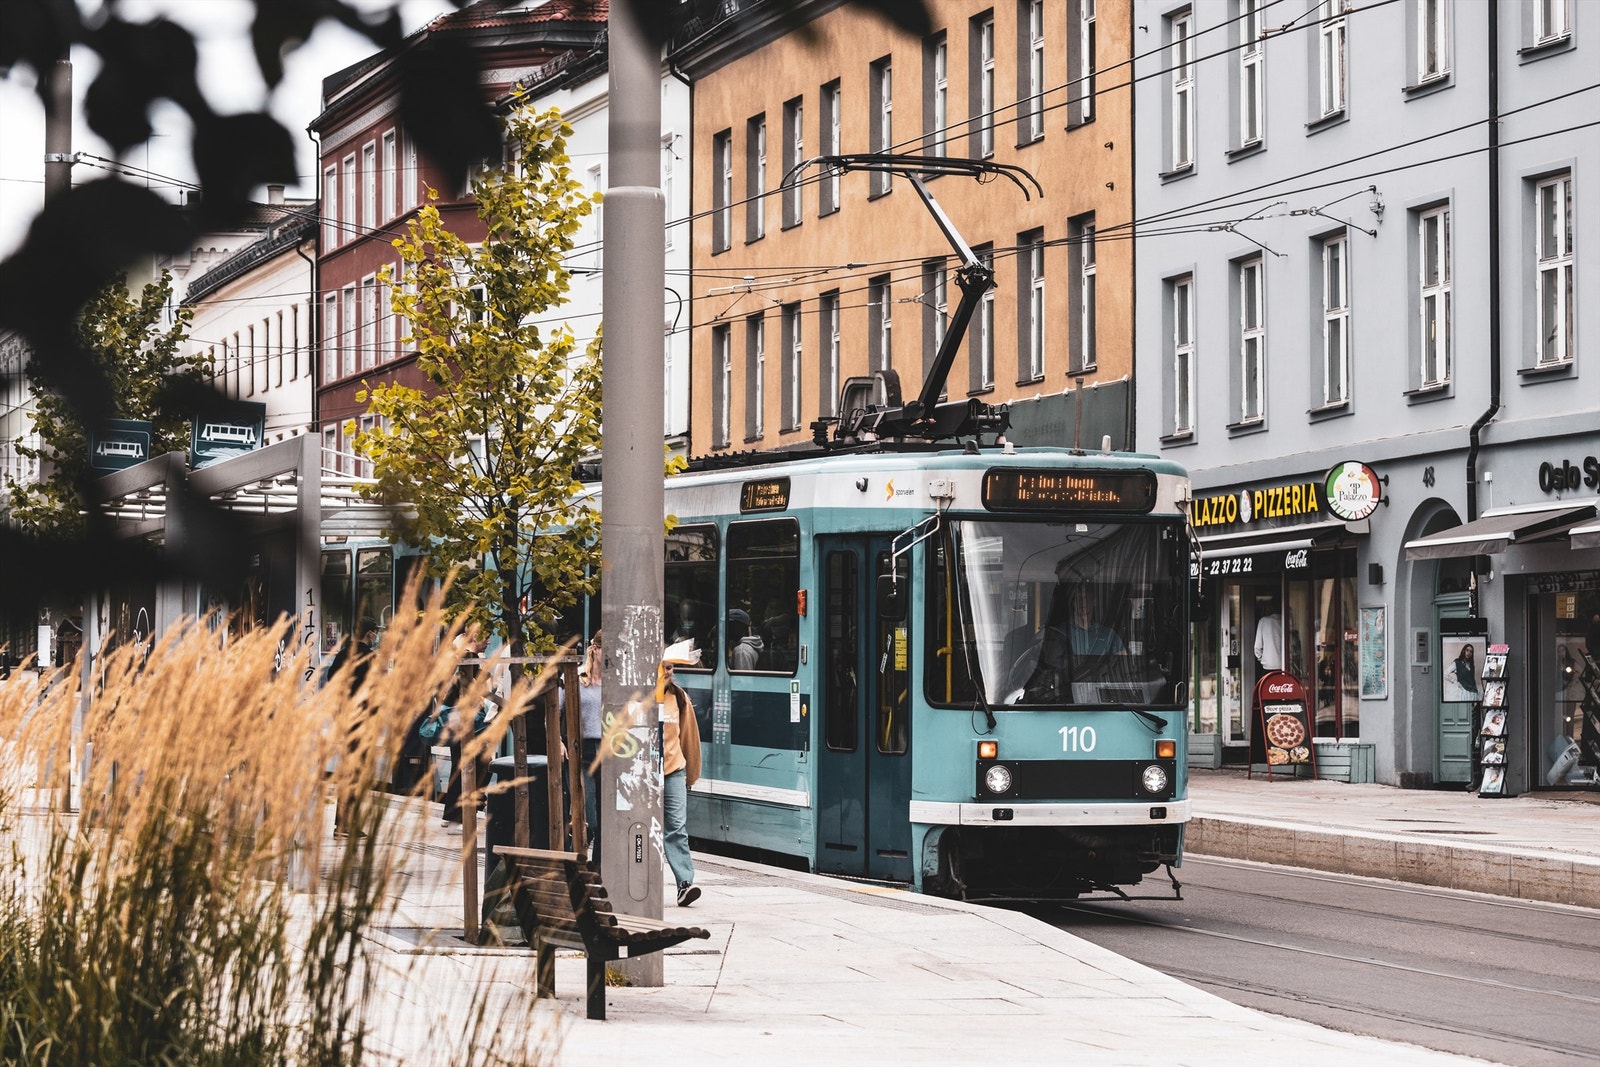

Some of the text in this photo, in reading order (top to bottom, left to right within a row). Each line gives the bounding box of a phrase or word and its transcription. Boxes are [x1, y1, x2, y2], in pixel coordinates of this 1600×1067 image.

[1422, 466, 1435, 488] 48
[1538, 456, 1600, 494] Oslo S
[1254, 482, 1319, 519] PIZZERIA
[1339, 490, 1367, 502] Palazzo
[1329, 498, 1378, 520] PIZZERIA
[1210, 560, 1220, 575] 22
[1221, 559, 1231, 574] 37
[1232, 558, 1241, 573] 22
[1243, 557, 1253, 572] 22
[1268, 683, 1294, 694] Coca-Cola
[1058, 726, 1097, 752] 110
